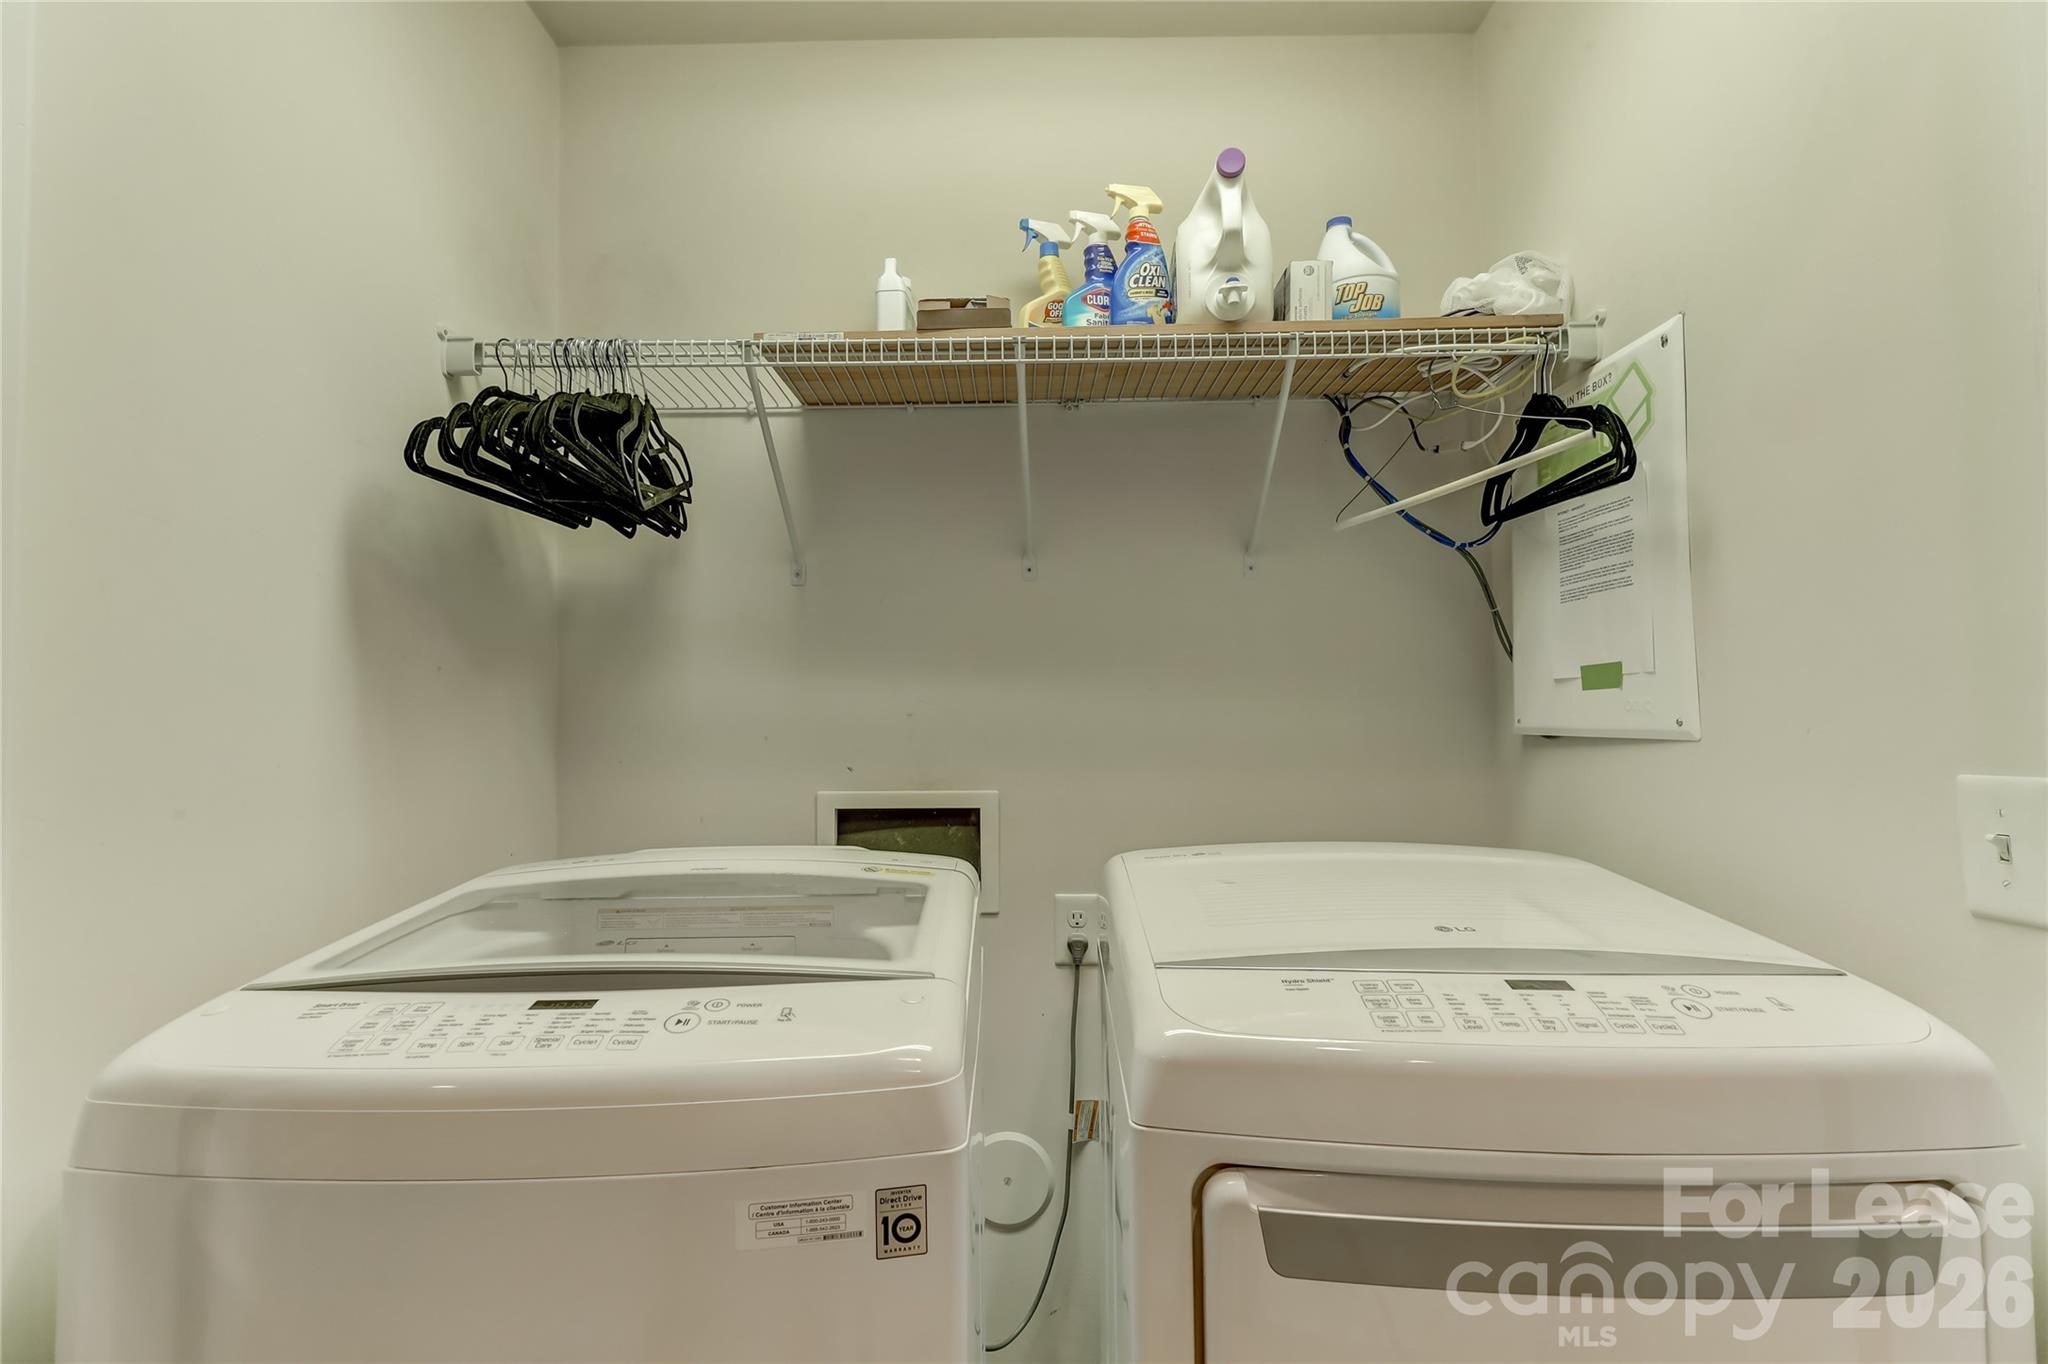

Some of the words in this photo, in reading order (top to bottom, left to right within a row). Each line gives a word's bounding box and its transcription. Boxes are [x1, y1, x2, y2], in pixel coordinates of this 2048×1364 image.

[1140, 262, 1160, 276] OXI
[1129, 273, 1166, 288] CLEAN
[1334, 281, 1368, 305] TOP
[1349, 293, 1385, 314] JOB
[1576, 385, 1591, 401] THE
[1592, 372, 1612, 392] BOX?
[760, 1203, 788, 1211] Customer
[880, 1196, 902, 1205] Direct
[776, 1208, 814, 1216] d'Information
[881, 1213, 922, 1246] 10
[899, 1225, 914, 1233] YEAR
[884, 1245, 921, 1254] WARRANTY
